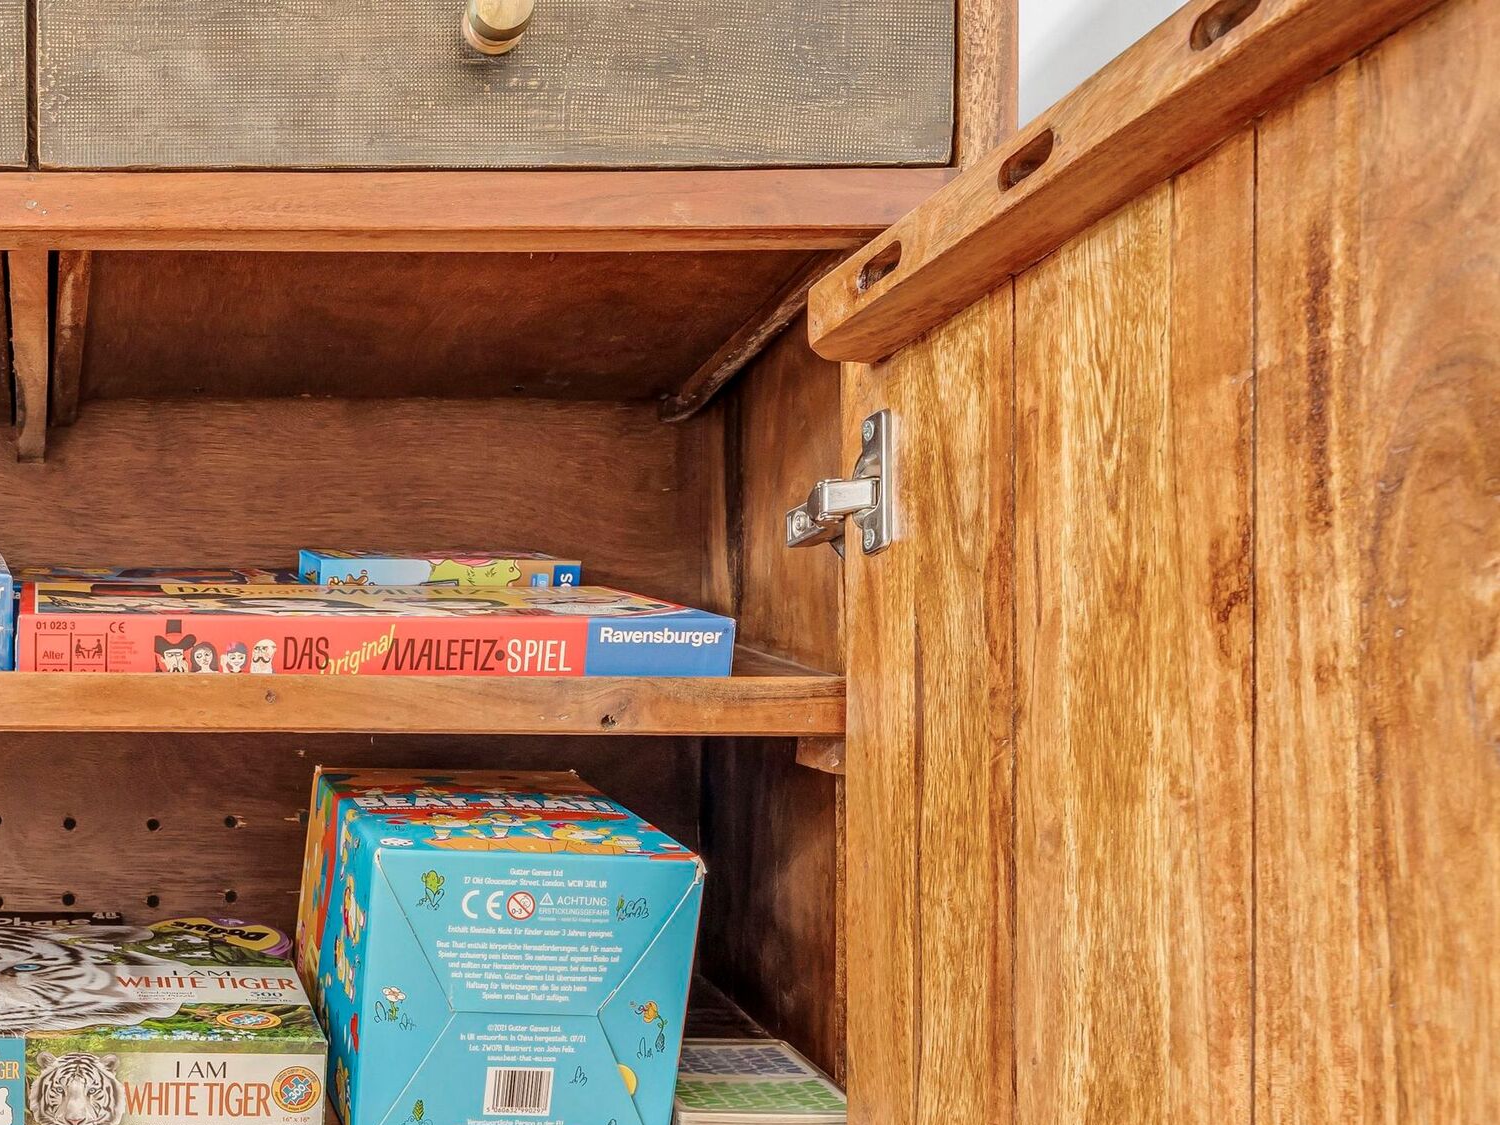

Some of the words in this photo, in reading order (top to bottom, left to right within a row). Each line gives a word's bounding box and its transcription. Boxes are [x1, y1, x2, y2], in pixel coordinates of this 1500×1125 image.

[36, 621, 47, 630] 01
[49, 621, 68, 630] 023
[600, 627, 723, 647] Ravensburger
[42, 650, 65, 660] Alter
[283, 636, 330, 670] DAS
[381, 638, 499, 671] MALEFIZ
[506, 638, 573, 672] SPIEL
[116, 976, 208, 989] WHITE
[210, 977, 297, 990] TIGER
[188, 1061, 227, 1079] AM
[123, 1082, 199, 1116] WHITE
[203, 1082, 271, 1117] TIGER
[288, 1084, 306, 1100] 300
